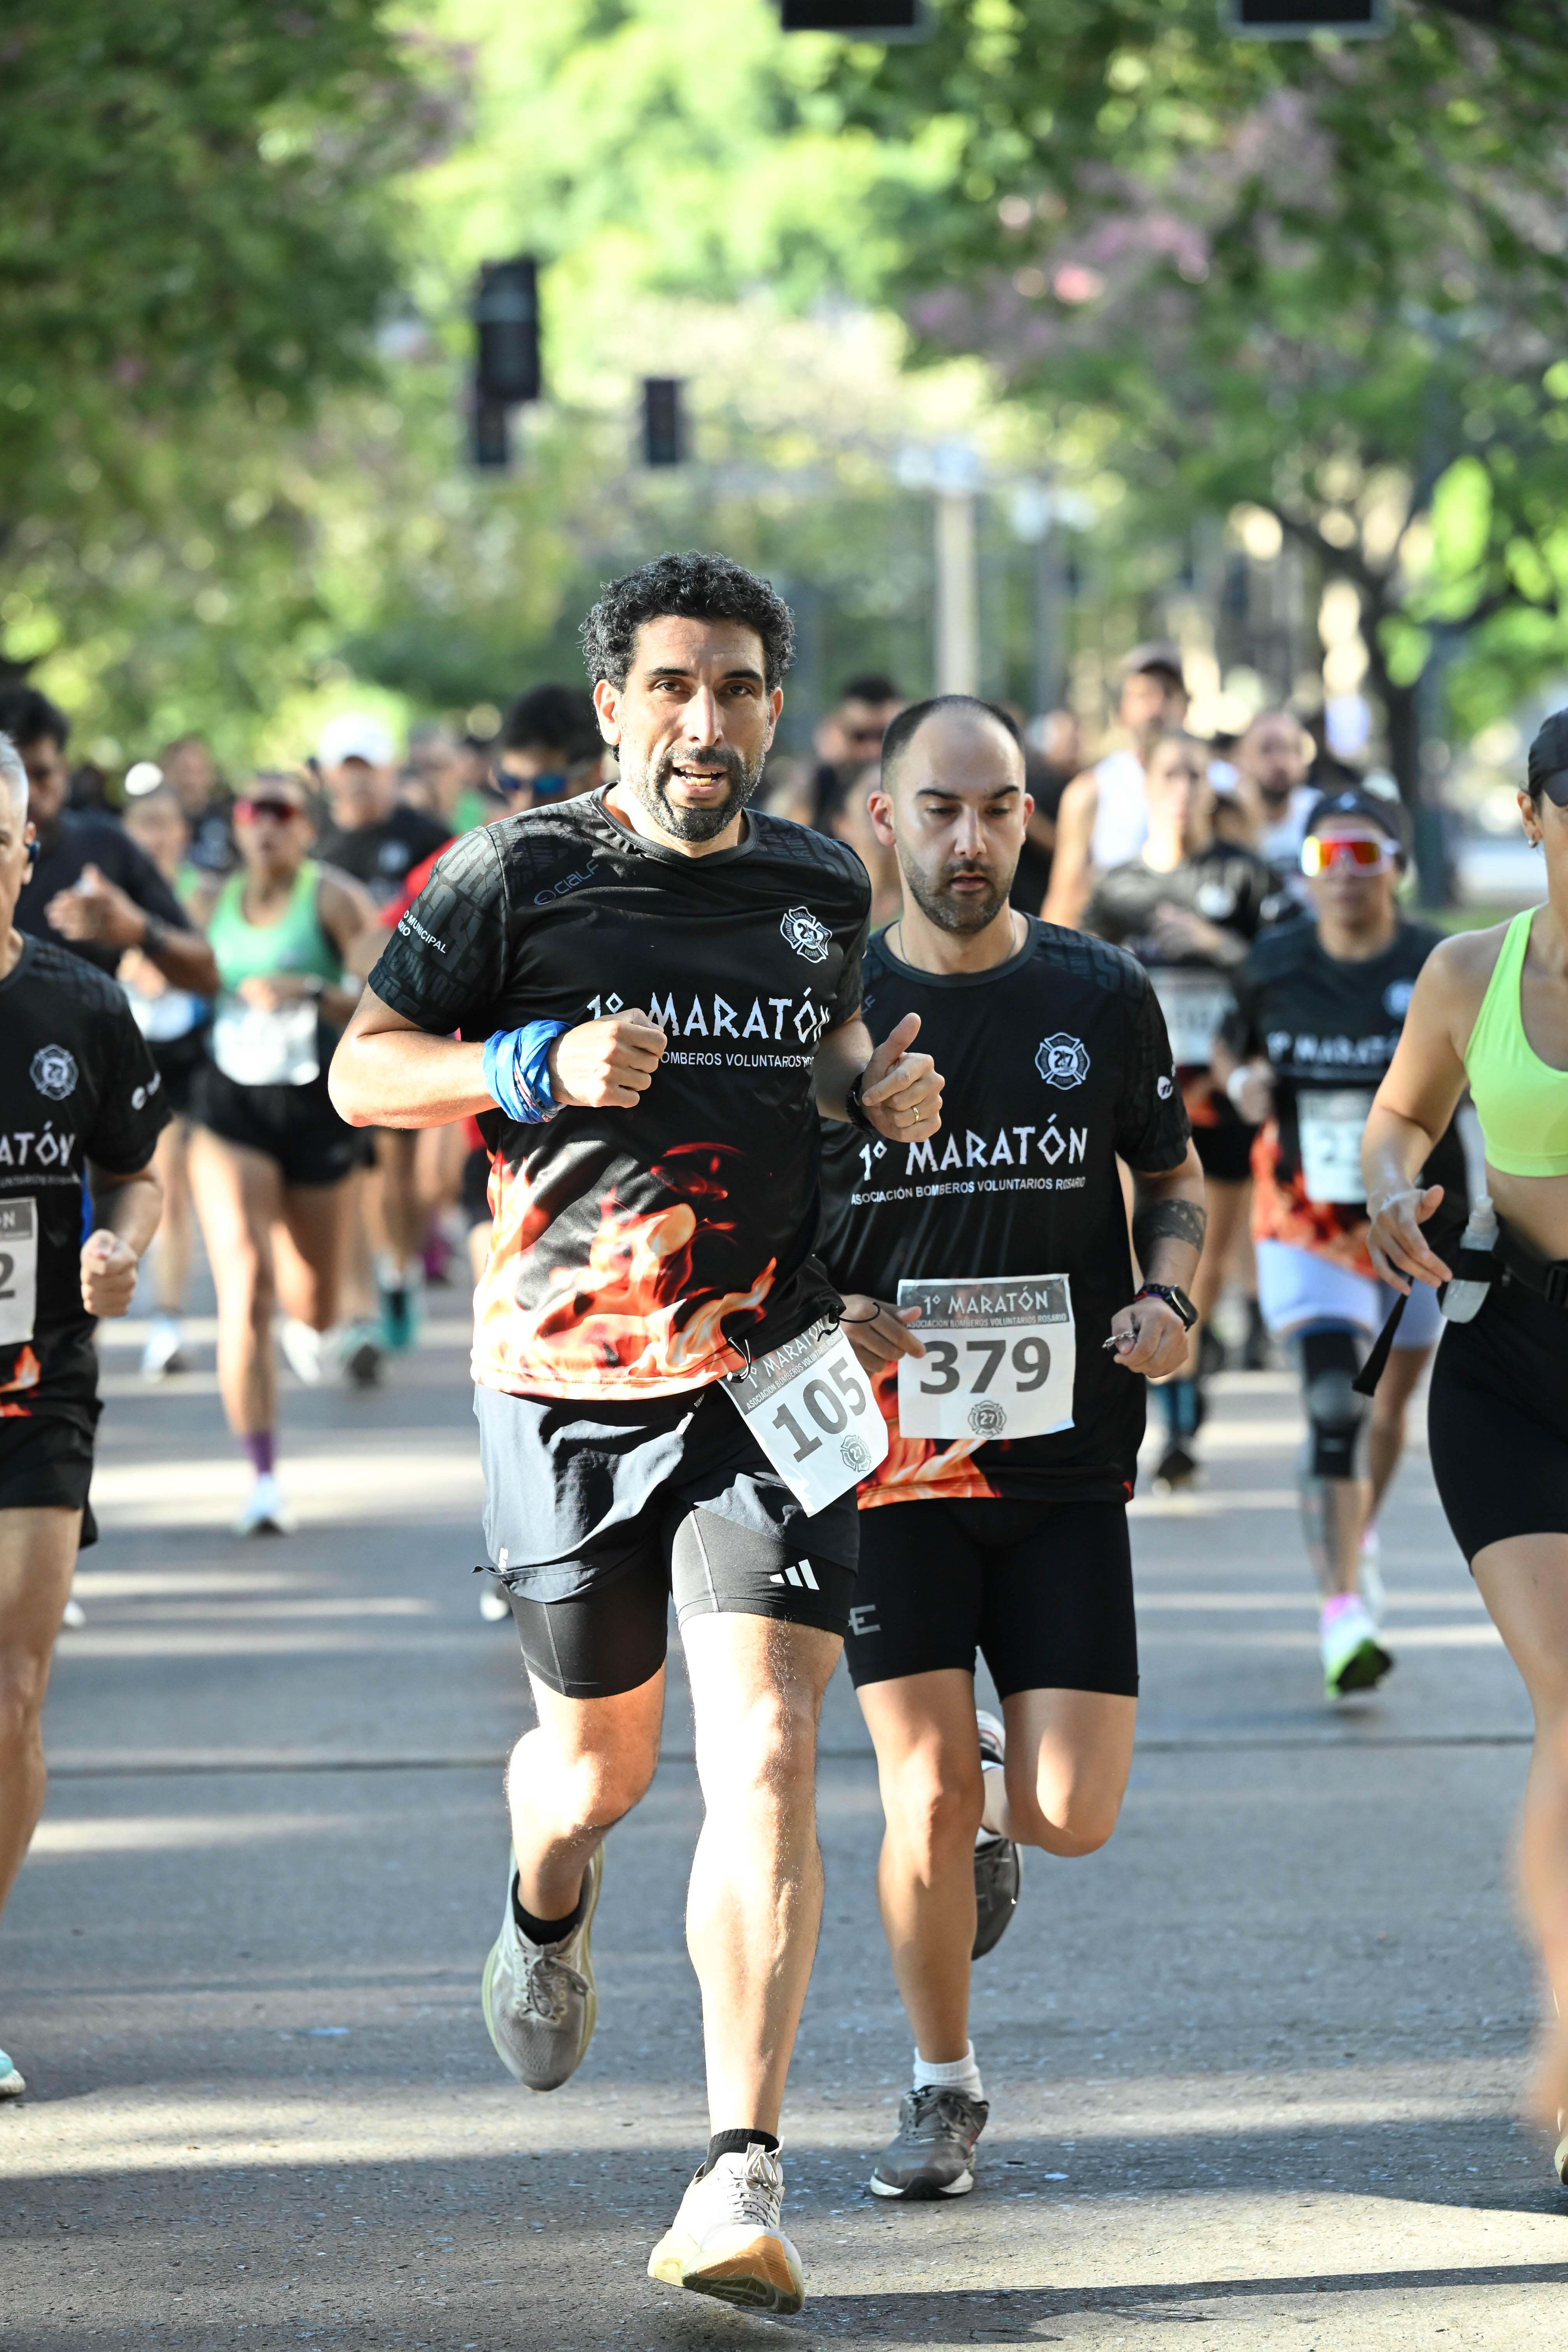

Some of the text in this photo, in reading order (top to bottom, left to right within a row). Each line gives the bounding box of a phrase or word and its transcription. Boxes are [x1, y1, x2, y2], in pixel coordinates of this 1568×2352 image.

[407, 915, 446, 954] MUNICIPAL
[660, 1051, 722, 1066] OMBEROS
[726, 1053, 801, 1068] VOLUNTAROS
[905, 1113, 1087, 1176] MARATÓN
[851, 1186, 913, 1206] ASOCIACIÓN
[915, 1181, 975, 1198] BOMBEROS
[977, 1178, 1053, 1192] VOLUNTARIOS
[948, 1285, 1049, 1315] MARATÓN
[950, 1318, 989, 1328] BOMBEROS
[990, 1316, 1036, 1326] VOLUNTARIOS
[1038, 1313, 1068, 1323] ROSARIO
[775, 1363, 804, 1388] BOMBEROS
[920, 1337, 1051, 1395] 379
[772, 1356, 866, 1463] 105
[980, 1412, 995, 1425] 27
[849, 1446, 863, 1461] 27
